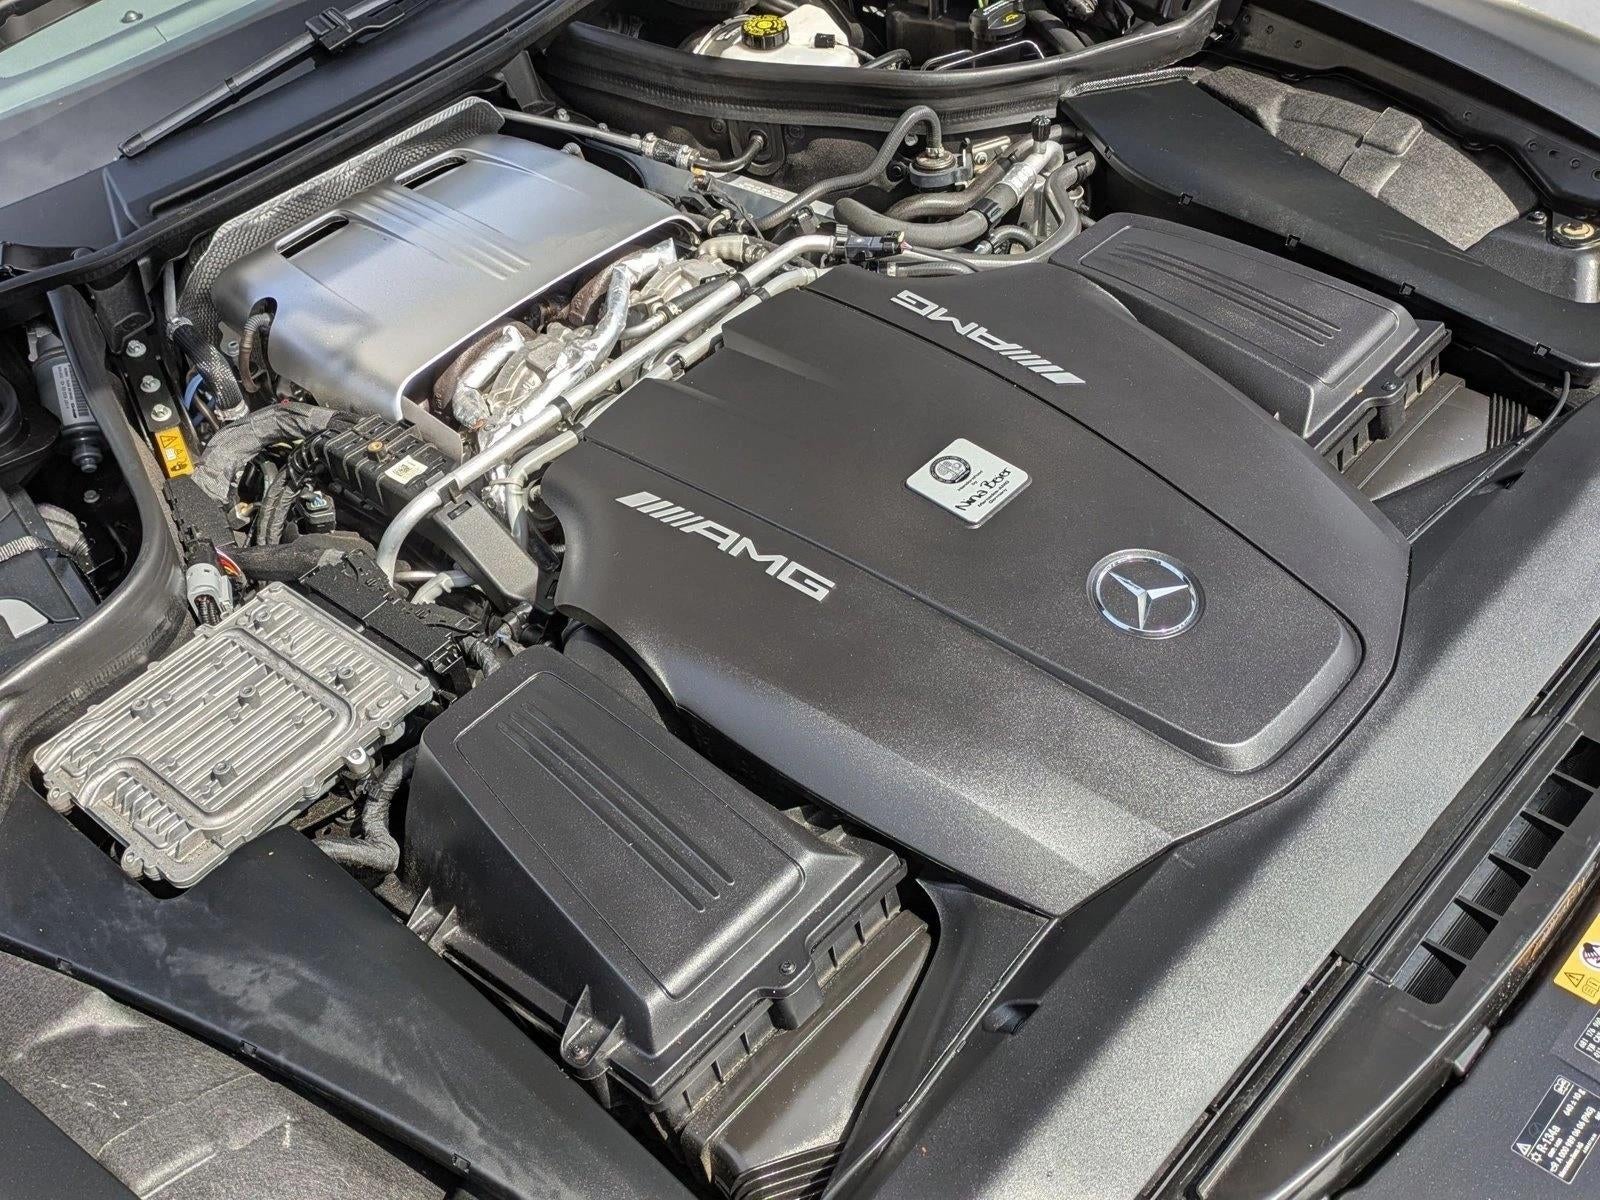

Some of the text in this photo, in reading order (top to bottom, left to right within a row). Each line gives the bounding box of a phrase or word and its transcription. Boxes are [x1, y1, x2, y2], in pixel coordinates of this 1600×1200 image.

[955, 489, 988, 510] Nina
[679, 520, 836, 601] AMG
[1536, 1125, 1561, 1153] R-134a
